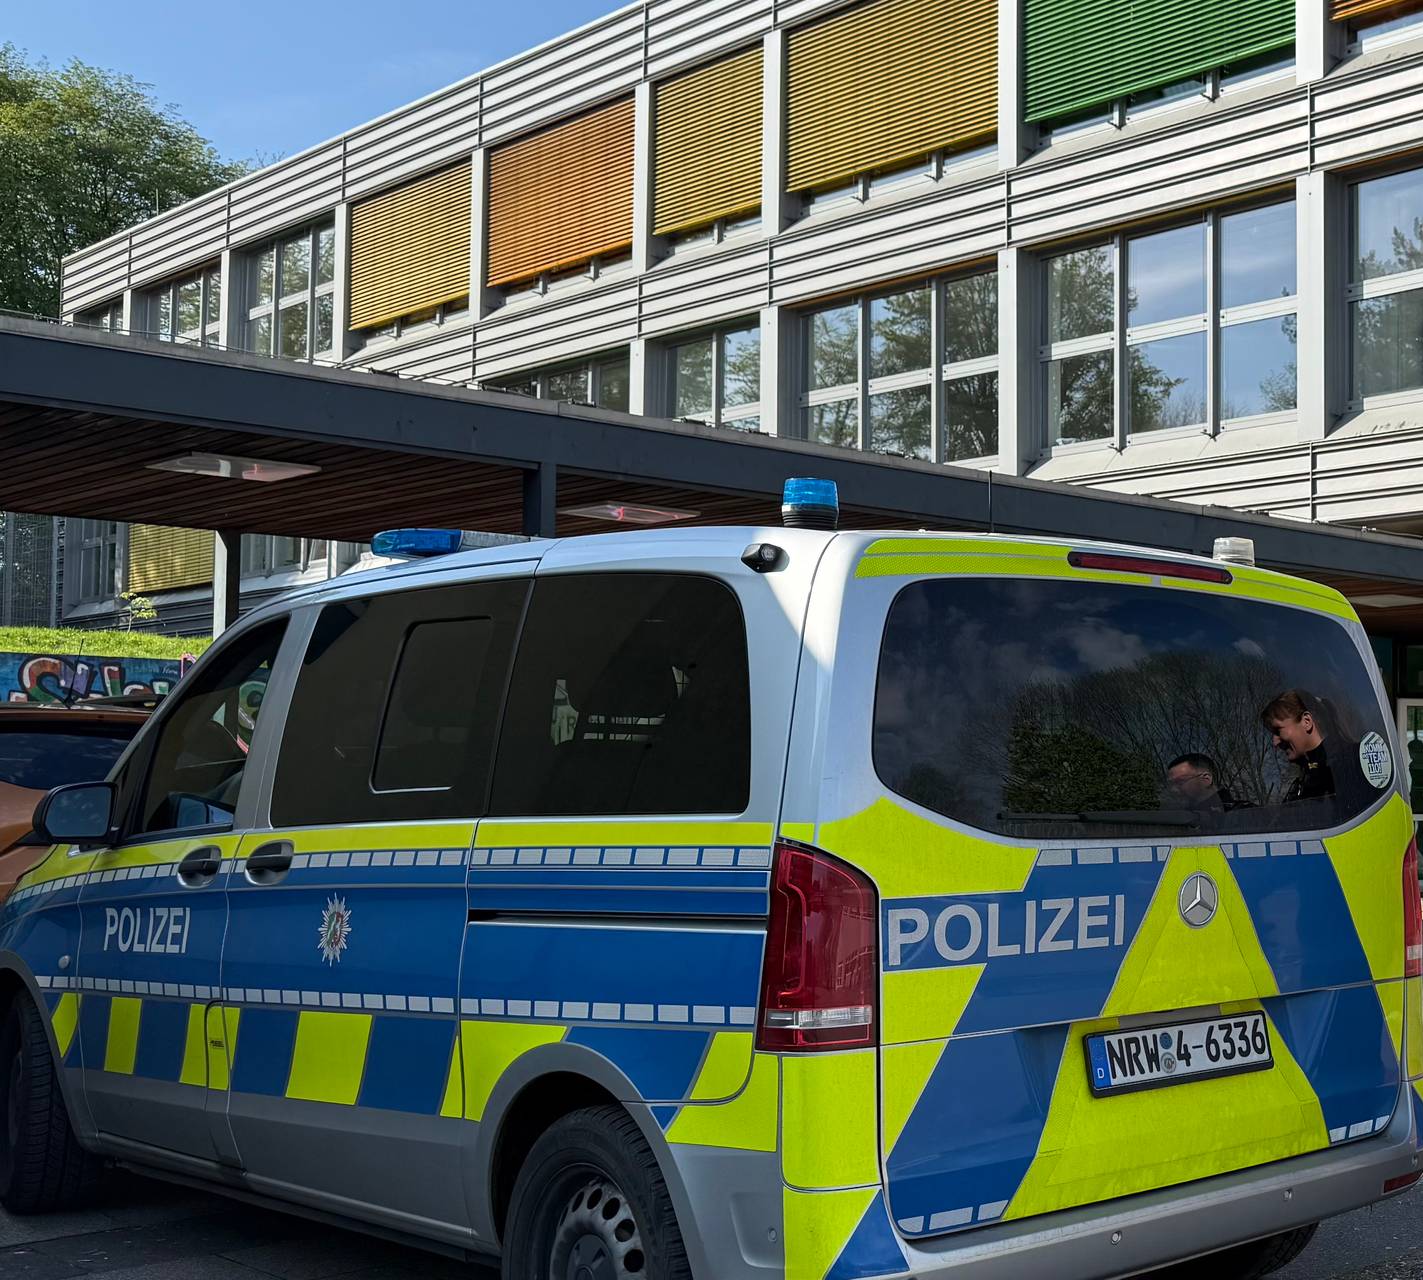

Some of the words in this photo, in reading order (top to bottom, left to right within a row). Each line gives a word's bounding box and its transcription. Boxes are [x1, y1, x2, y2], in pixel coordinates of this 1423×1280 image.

[1368, 752, 1388, 762] TEAM
[104, 907, 190, 953] POLIZEI
[888, 894, 1124, 966] POLIZEI
[1097, 1068, 1105, 1079] D
[1106, 1033, 1161, 1079] NRW
[1176, 1018, 1266, 1067] 4-6336
